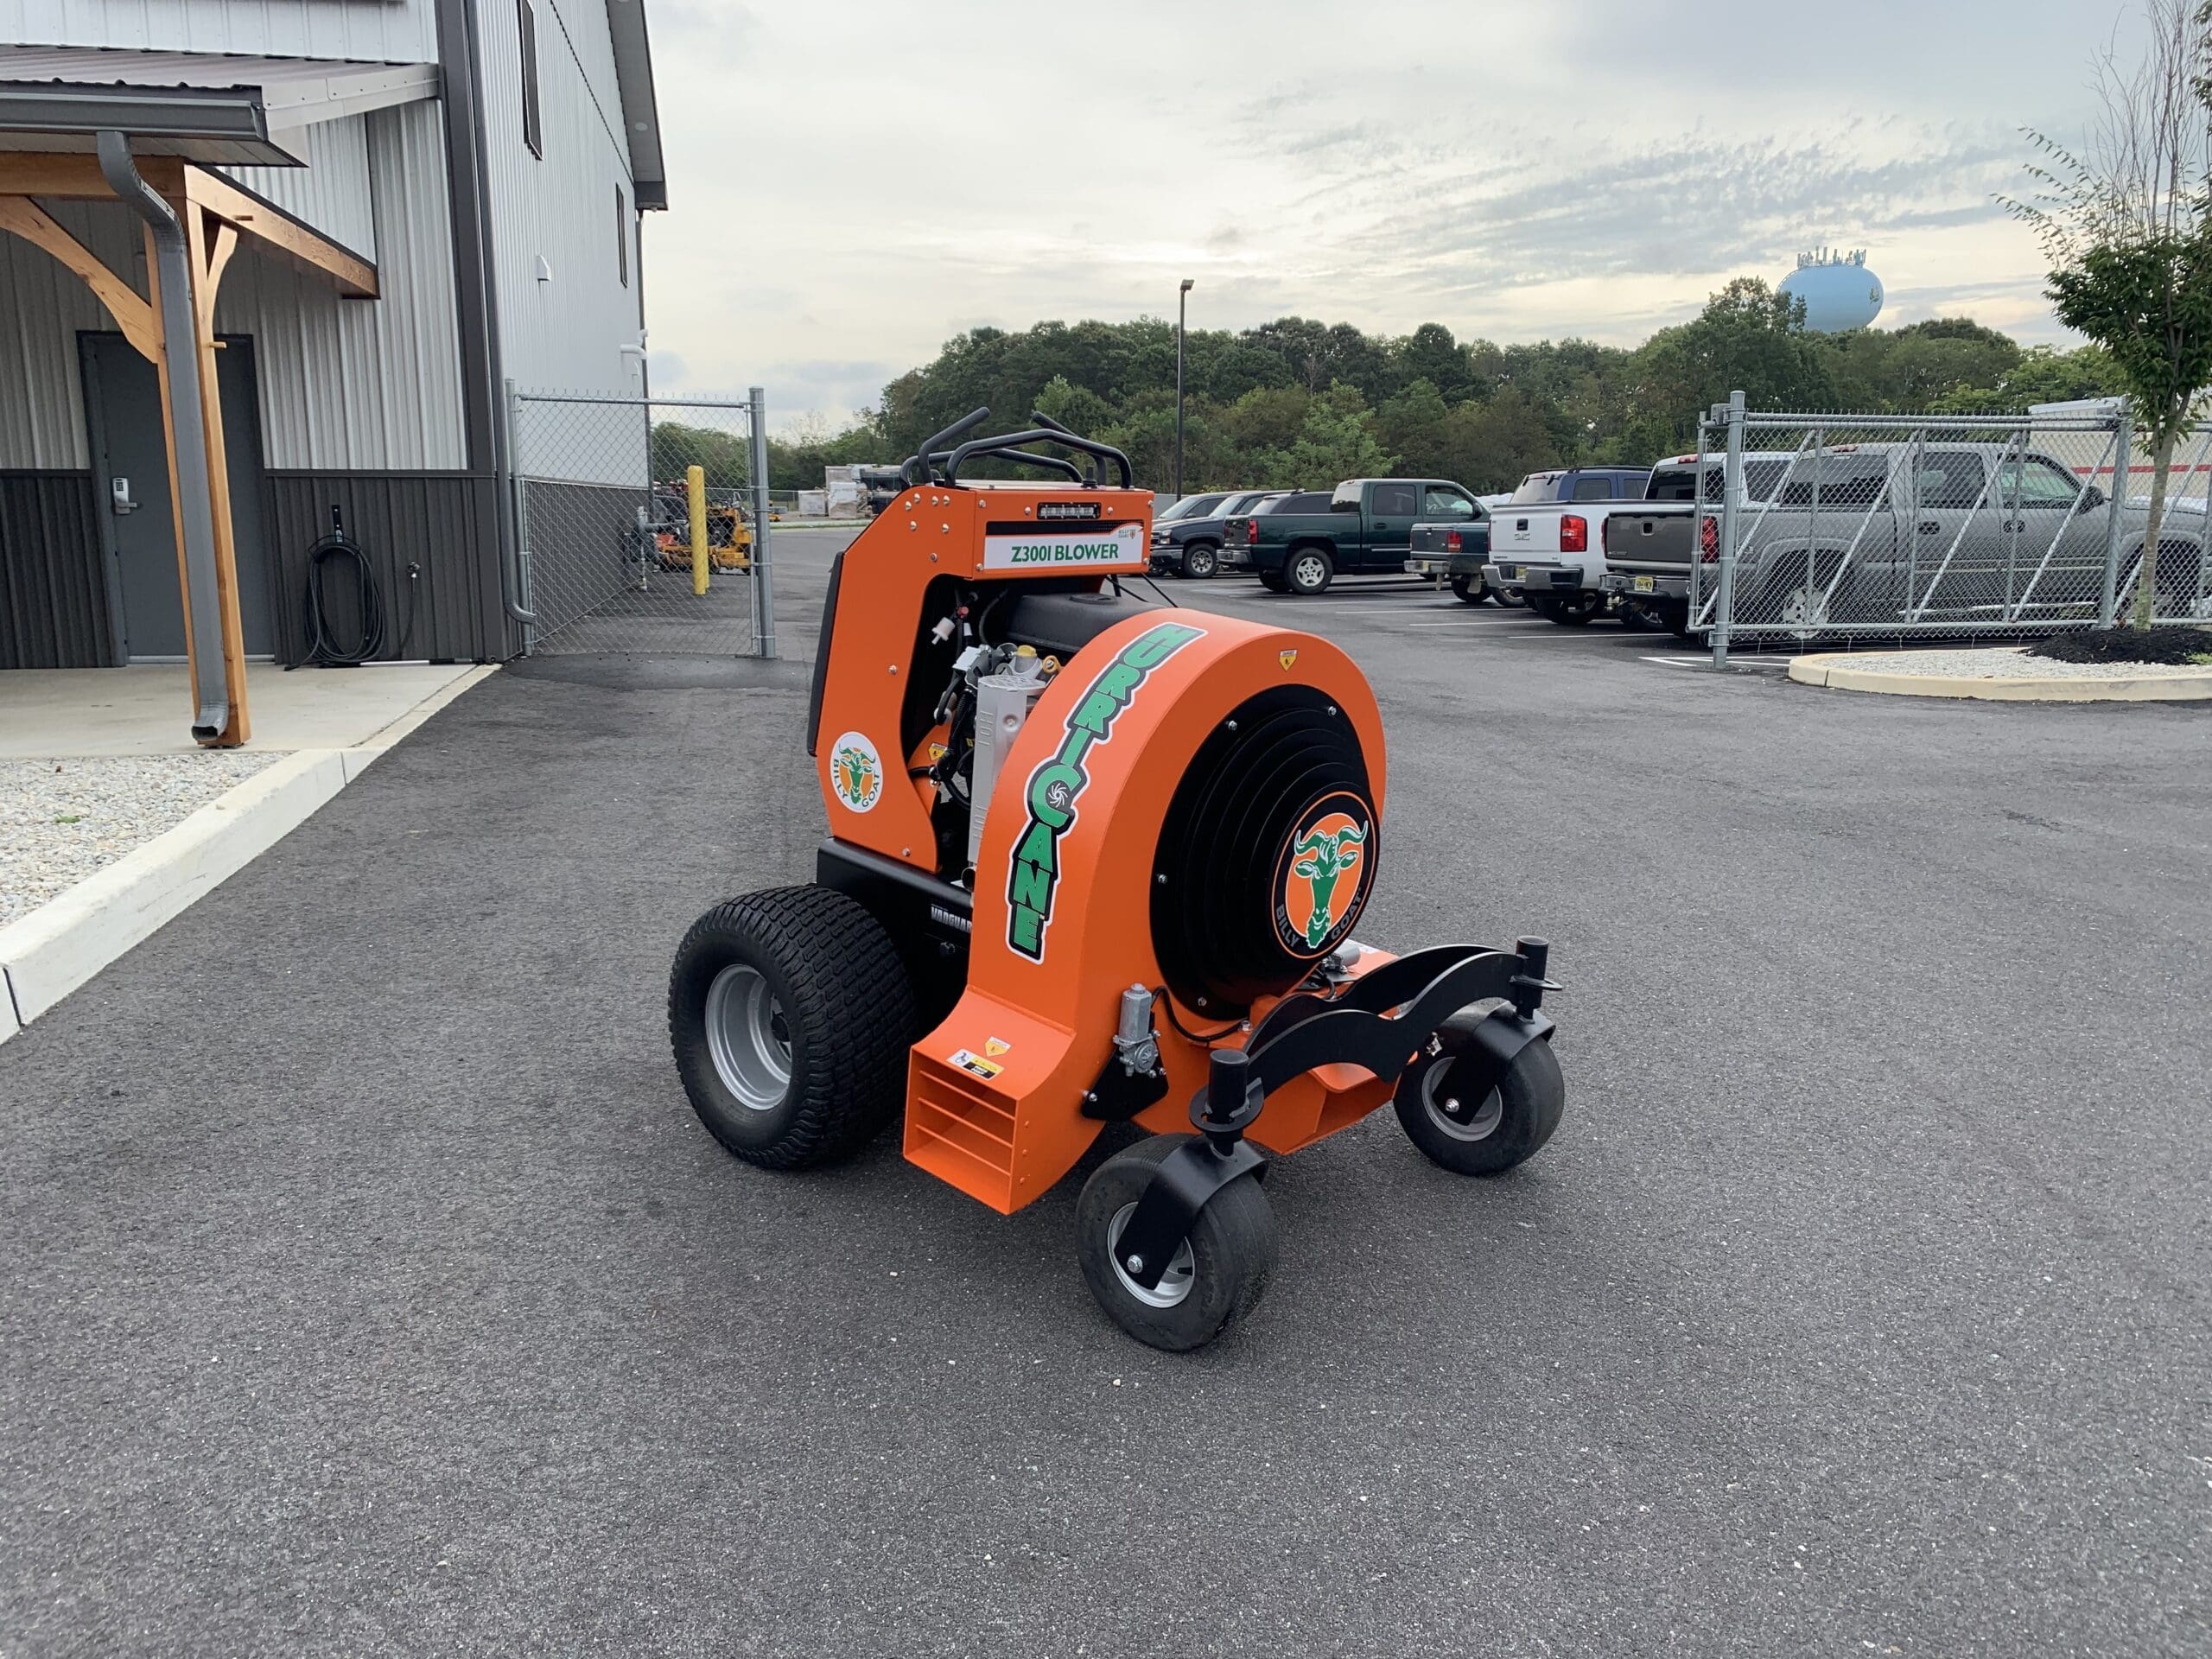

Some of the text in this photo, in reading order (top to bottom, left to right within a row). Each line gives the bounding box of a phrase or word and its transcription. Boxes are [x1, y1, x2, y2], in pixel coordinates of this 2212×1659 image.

[1054, 543, 1119, 562] BLOWER
[833, 759, 880, 807] BILLY GOAT
[1010, 623, 1207, 961] HURRICANE
[931, 906, 973, 934] VANGUAR
[1275, 893, 1362, 949] BILLY GOAT
